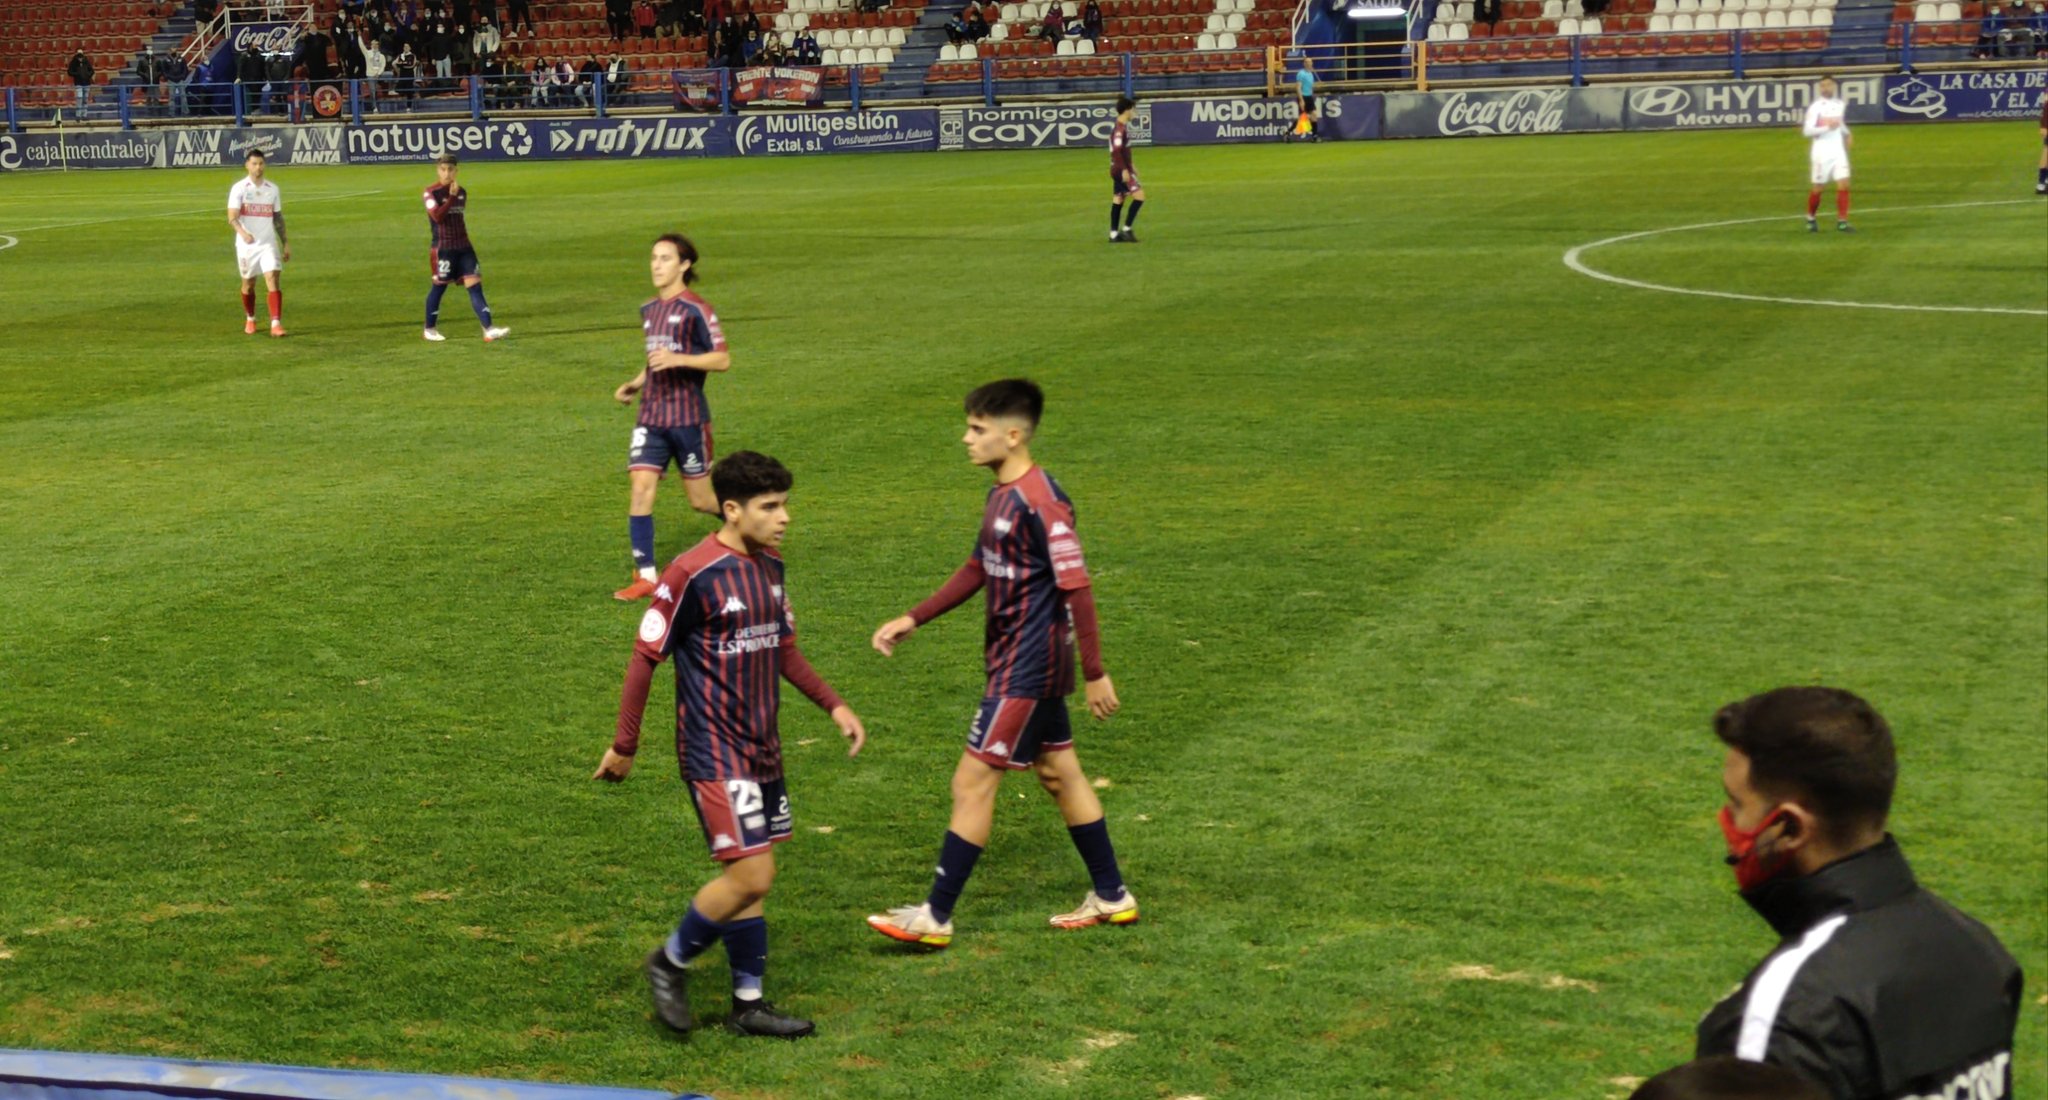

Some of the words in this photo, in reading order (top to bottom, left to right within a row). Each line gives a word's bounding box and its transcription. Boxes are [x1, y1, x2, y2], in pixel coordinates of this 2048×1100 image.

[1940, 73, 1963, 90] LA
[1969, 72, 2019, 89] CASA
[2023, 72, 2047, 88] DE
[1989, 90, 2005, 109] Y
[2008, 92, 2029, 108] EL
[968, 107, 1119, 123] hormigones
[1190, 97, 1342, 123] McDona's
[1438, 89, 1568, 136] Coca-Cola
[1676, 113, 1752, 126] Maven
[1757, 112, 1772, 123] e
[1776, 109, 1807, 124] hij
[766, 112, 899, 137] Multigestión
[942, 121, 962, 136] CP
[1215, 123, 1314, 139] Almendra
[348, 124, 499, 160] natuyser
[26, 138, 158, 166] cajalmendralejo
[172, 152, 222, 166] NANTA
[290, 150, 342, 164] NANTA
[438, 260, 451, 273] 22
